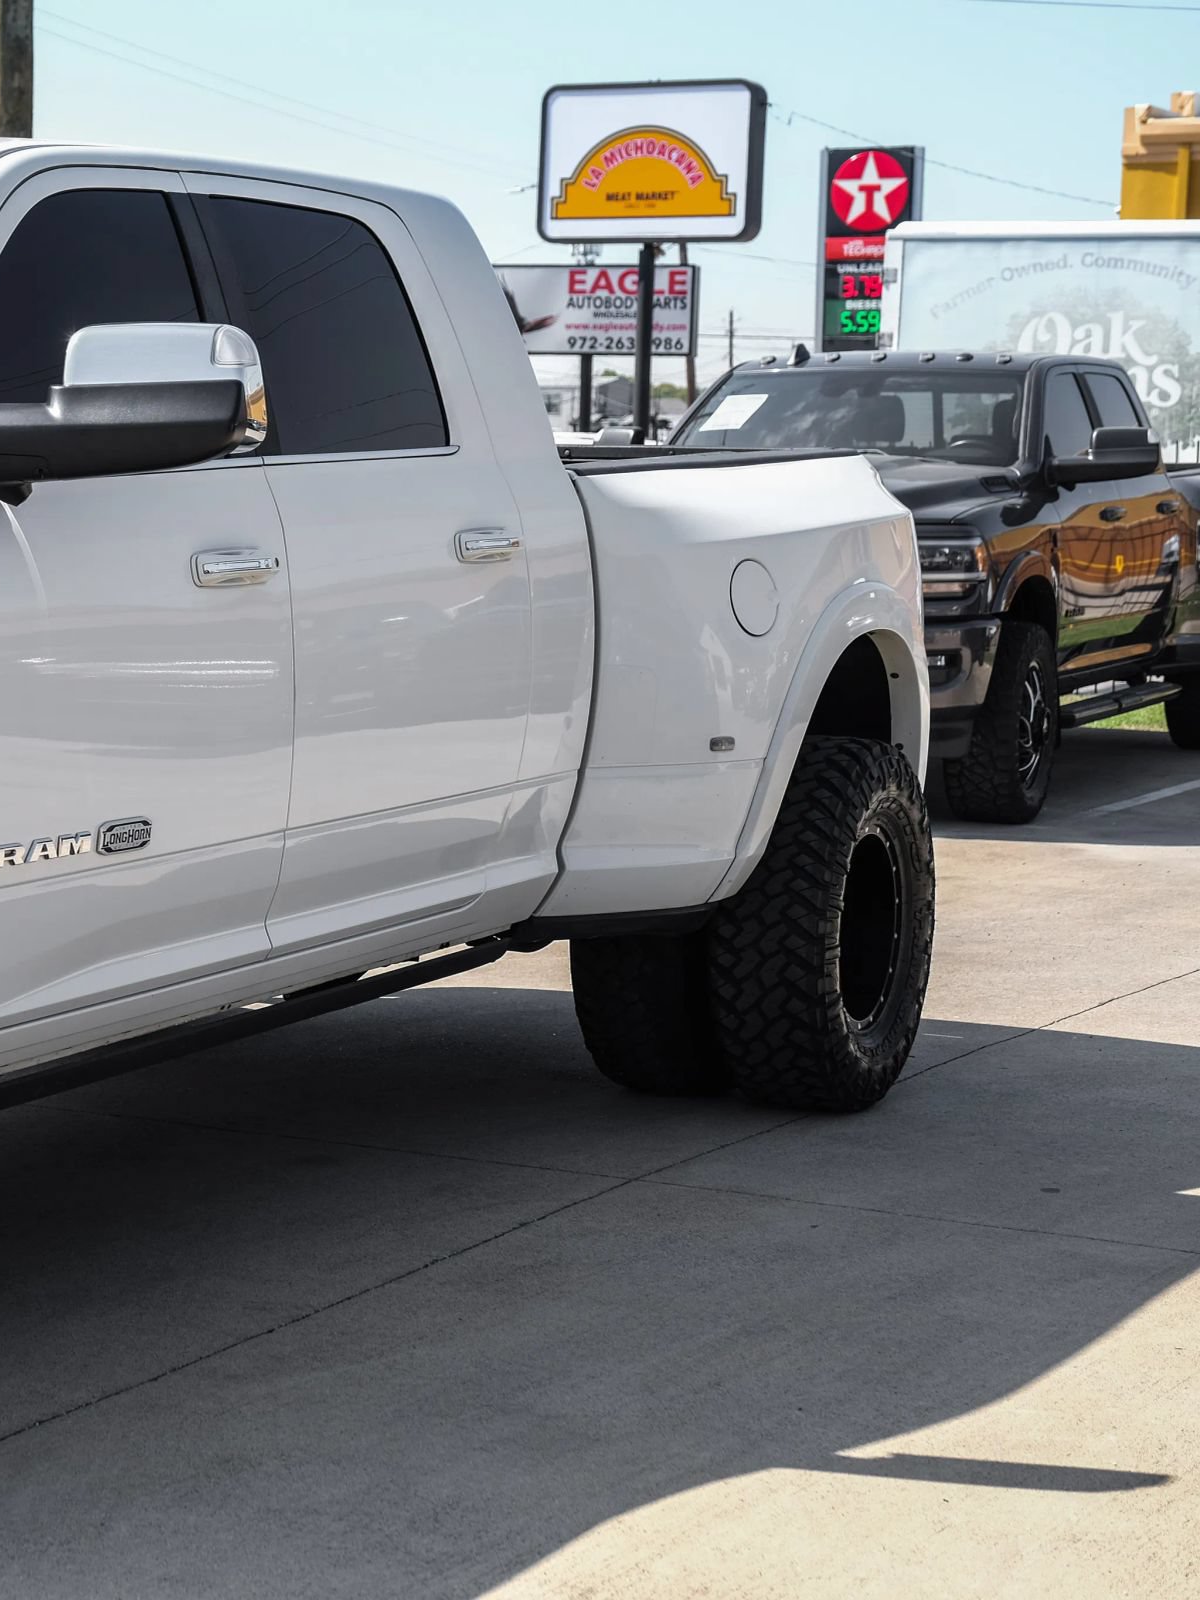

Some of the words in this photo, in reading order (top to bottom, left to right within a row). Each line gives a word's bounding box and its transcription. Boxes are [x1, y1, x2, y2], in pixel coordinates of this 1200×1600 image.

[581, 166, 606, 192] LA
[602, 138, 704, 190] MICHOACANA
[606, 191, 632, 202] MEAT
[635, 190, 676, 201] MARKET
[930, 275, 996, 320] Farmer
[1001, 253, 1073, 282] Owned.
[652, 297, 687, 309] ARTS
[840, 310, 881, 333] 5.59
[1017, 311, 1159, 365] Oak
[102, 827, 151, 847] LONGHORN
